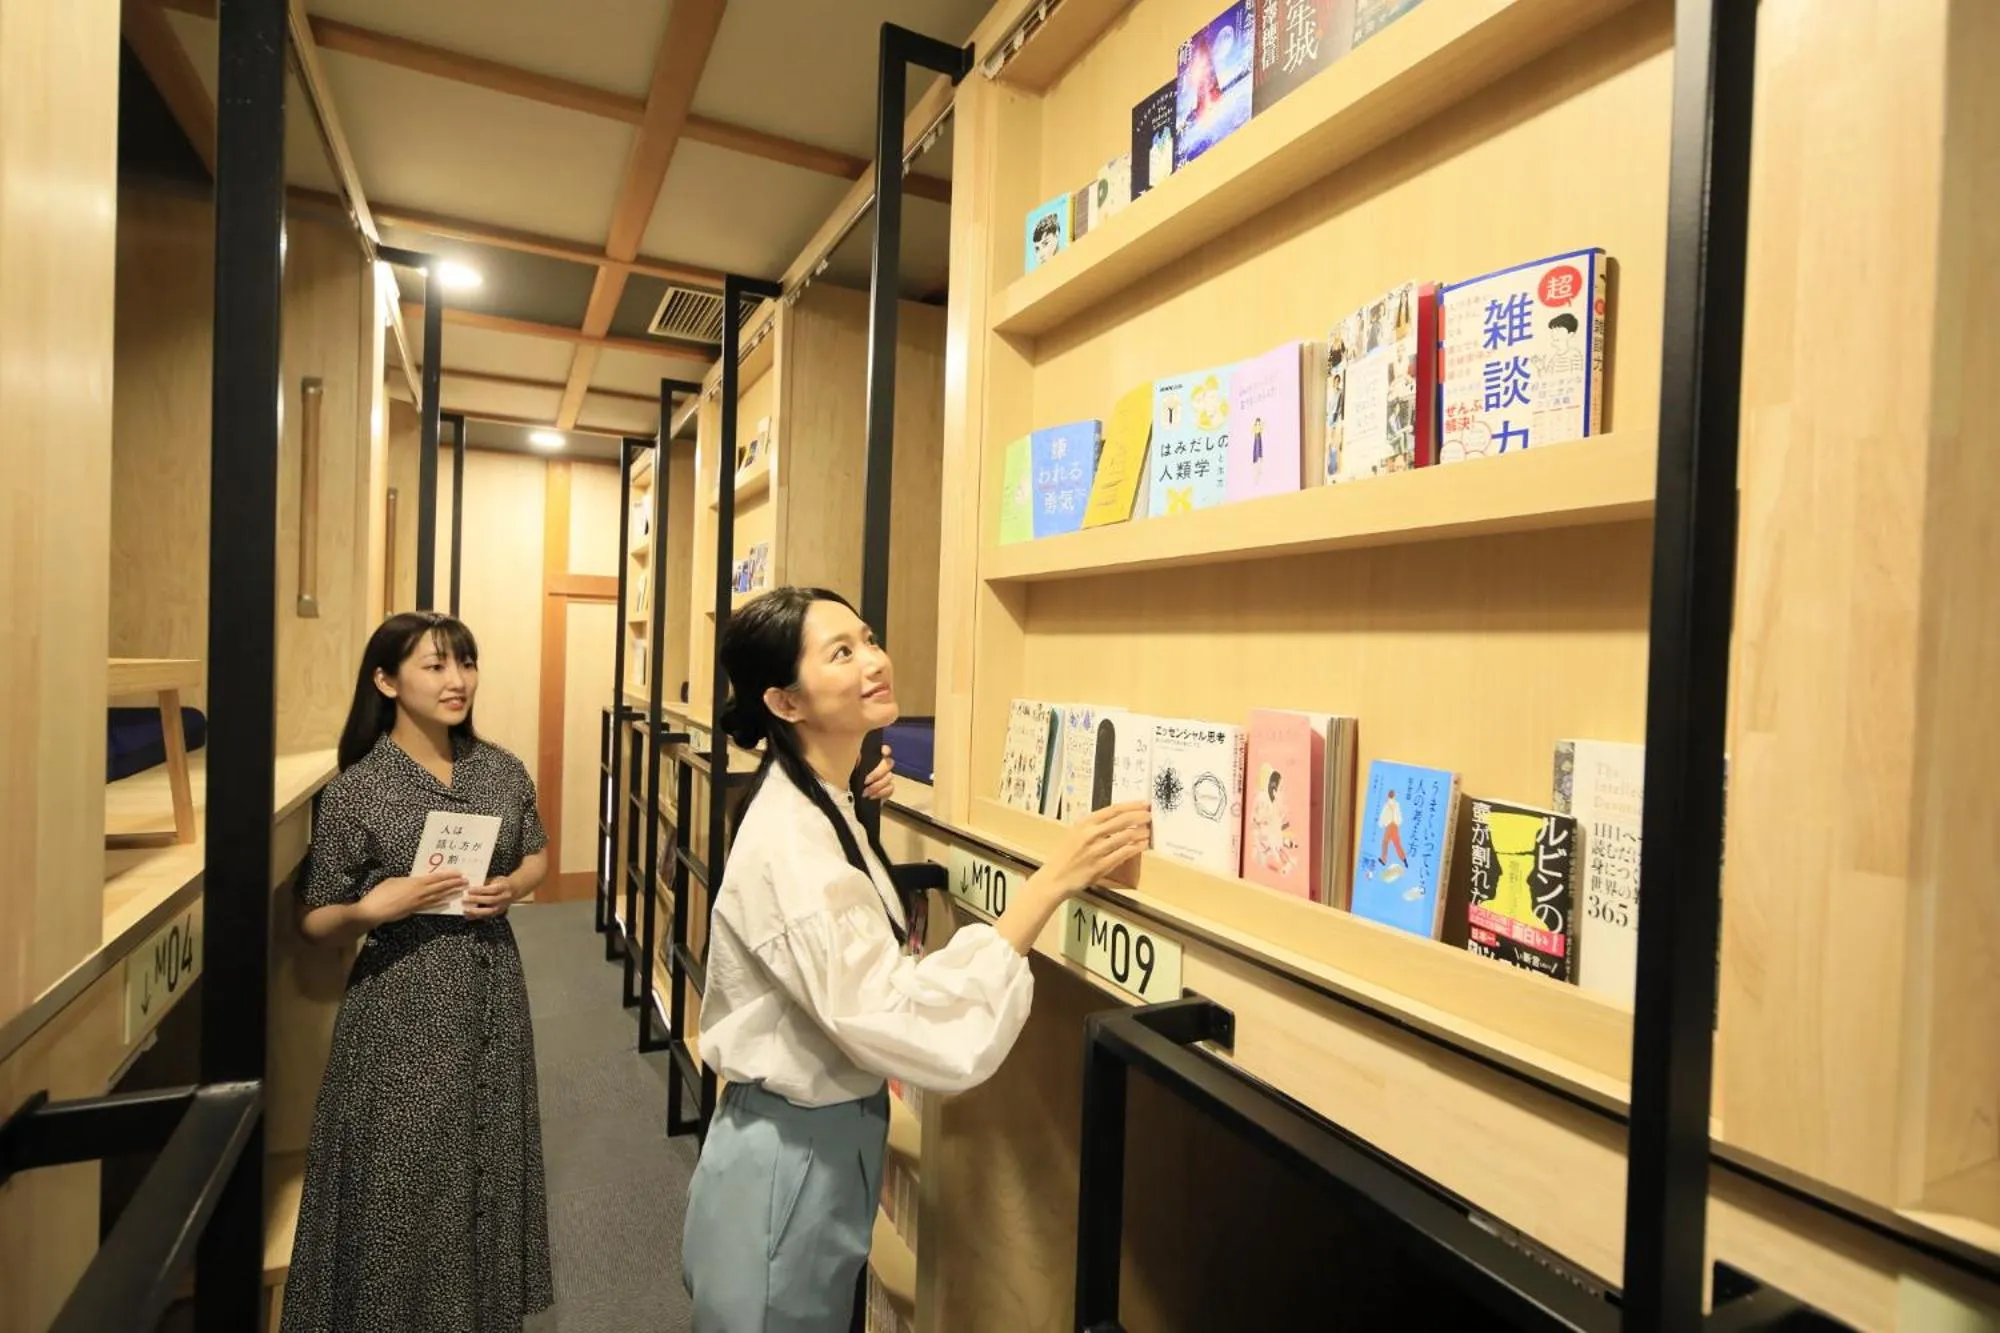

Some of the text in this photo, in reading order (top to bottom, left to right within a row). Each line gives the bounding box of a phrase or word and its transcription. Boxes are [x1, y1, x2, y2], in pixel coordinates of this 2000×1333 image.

[1547, 273, 1573, 302] 超
[1160, 434, 1229, 457] はみだしの
[1159, 459, 1210, 483] 人類学
[440, 825, 463, 835] 人は
[972, 859, 1007, 918] M10
[1534, 816, 1569, 934] ルビンの
[1587, 895, 1628, 929] 365
[154, 913, 193, 993] M04
[1091, 914, 1155, 995] M09
